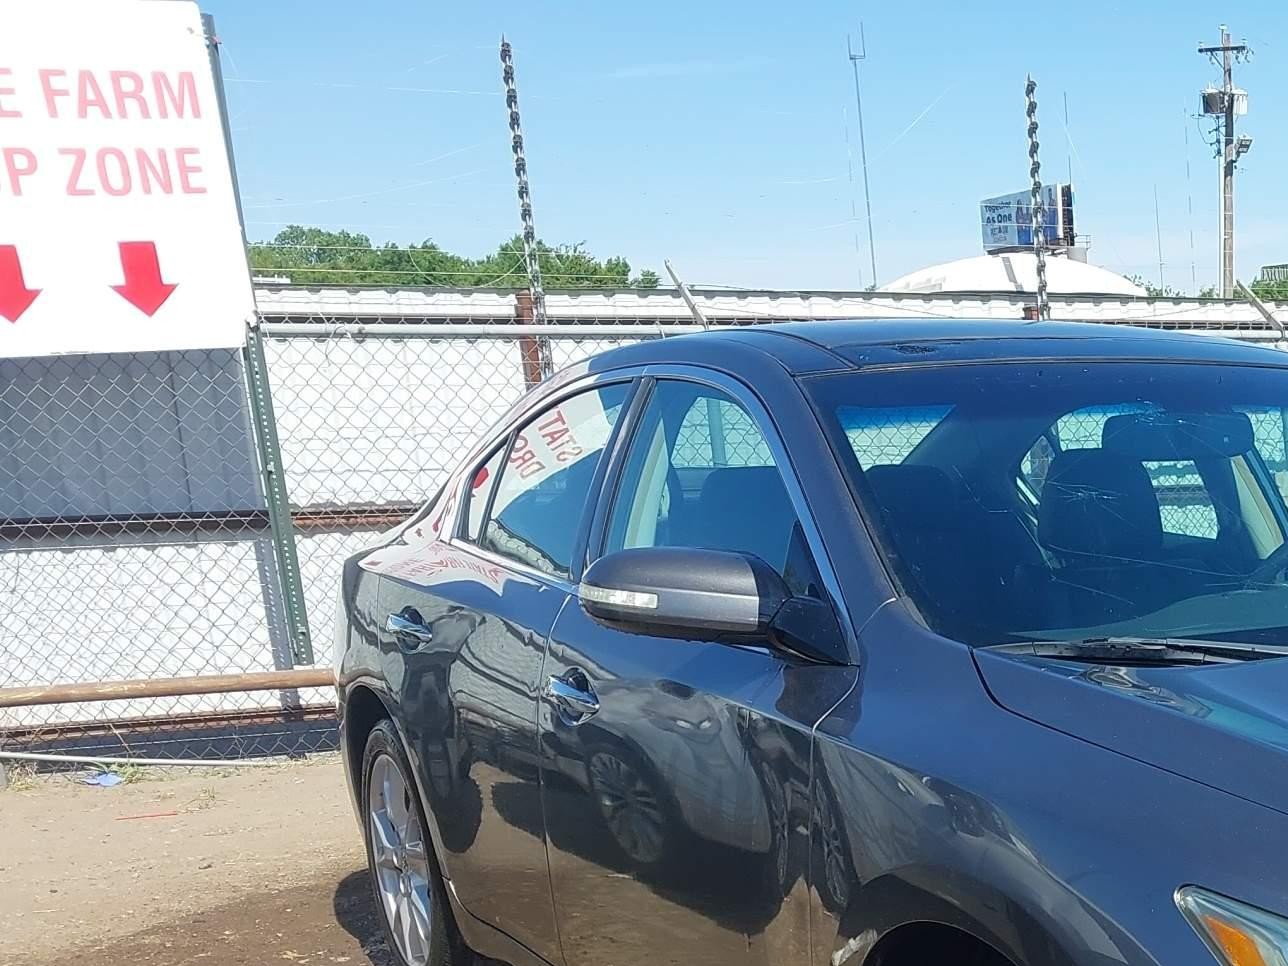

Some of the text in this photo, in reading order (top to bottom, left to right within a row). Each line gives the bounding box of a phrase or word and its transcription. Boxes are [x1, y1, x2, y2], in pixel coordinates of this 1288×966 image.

[38, 69, 202, 120] FARM
[0, 147, 208, 197] P ZONE
[997, 213, 1013, 224] One
